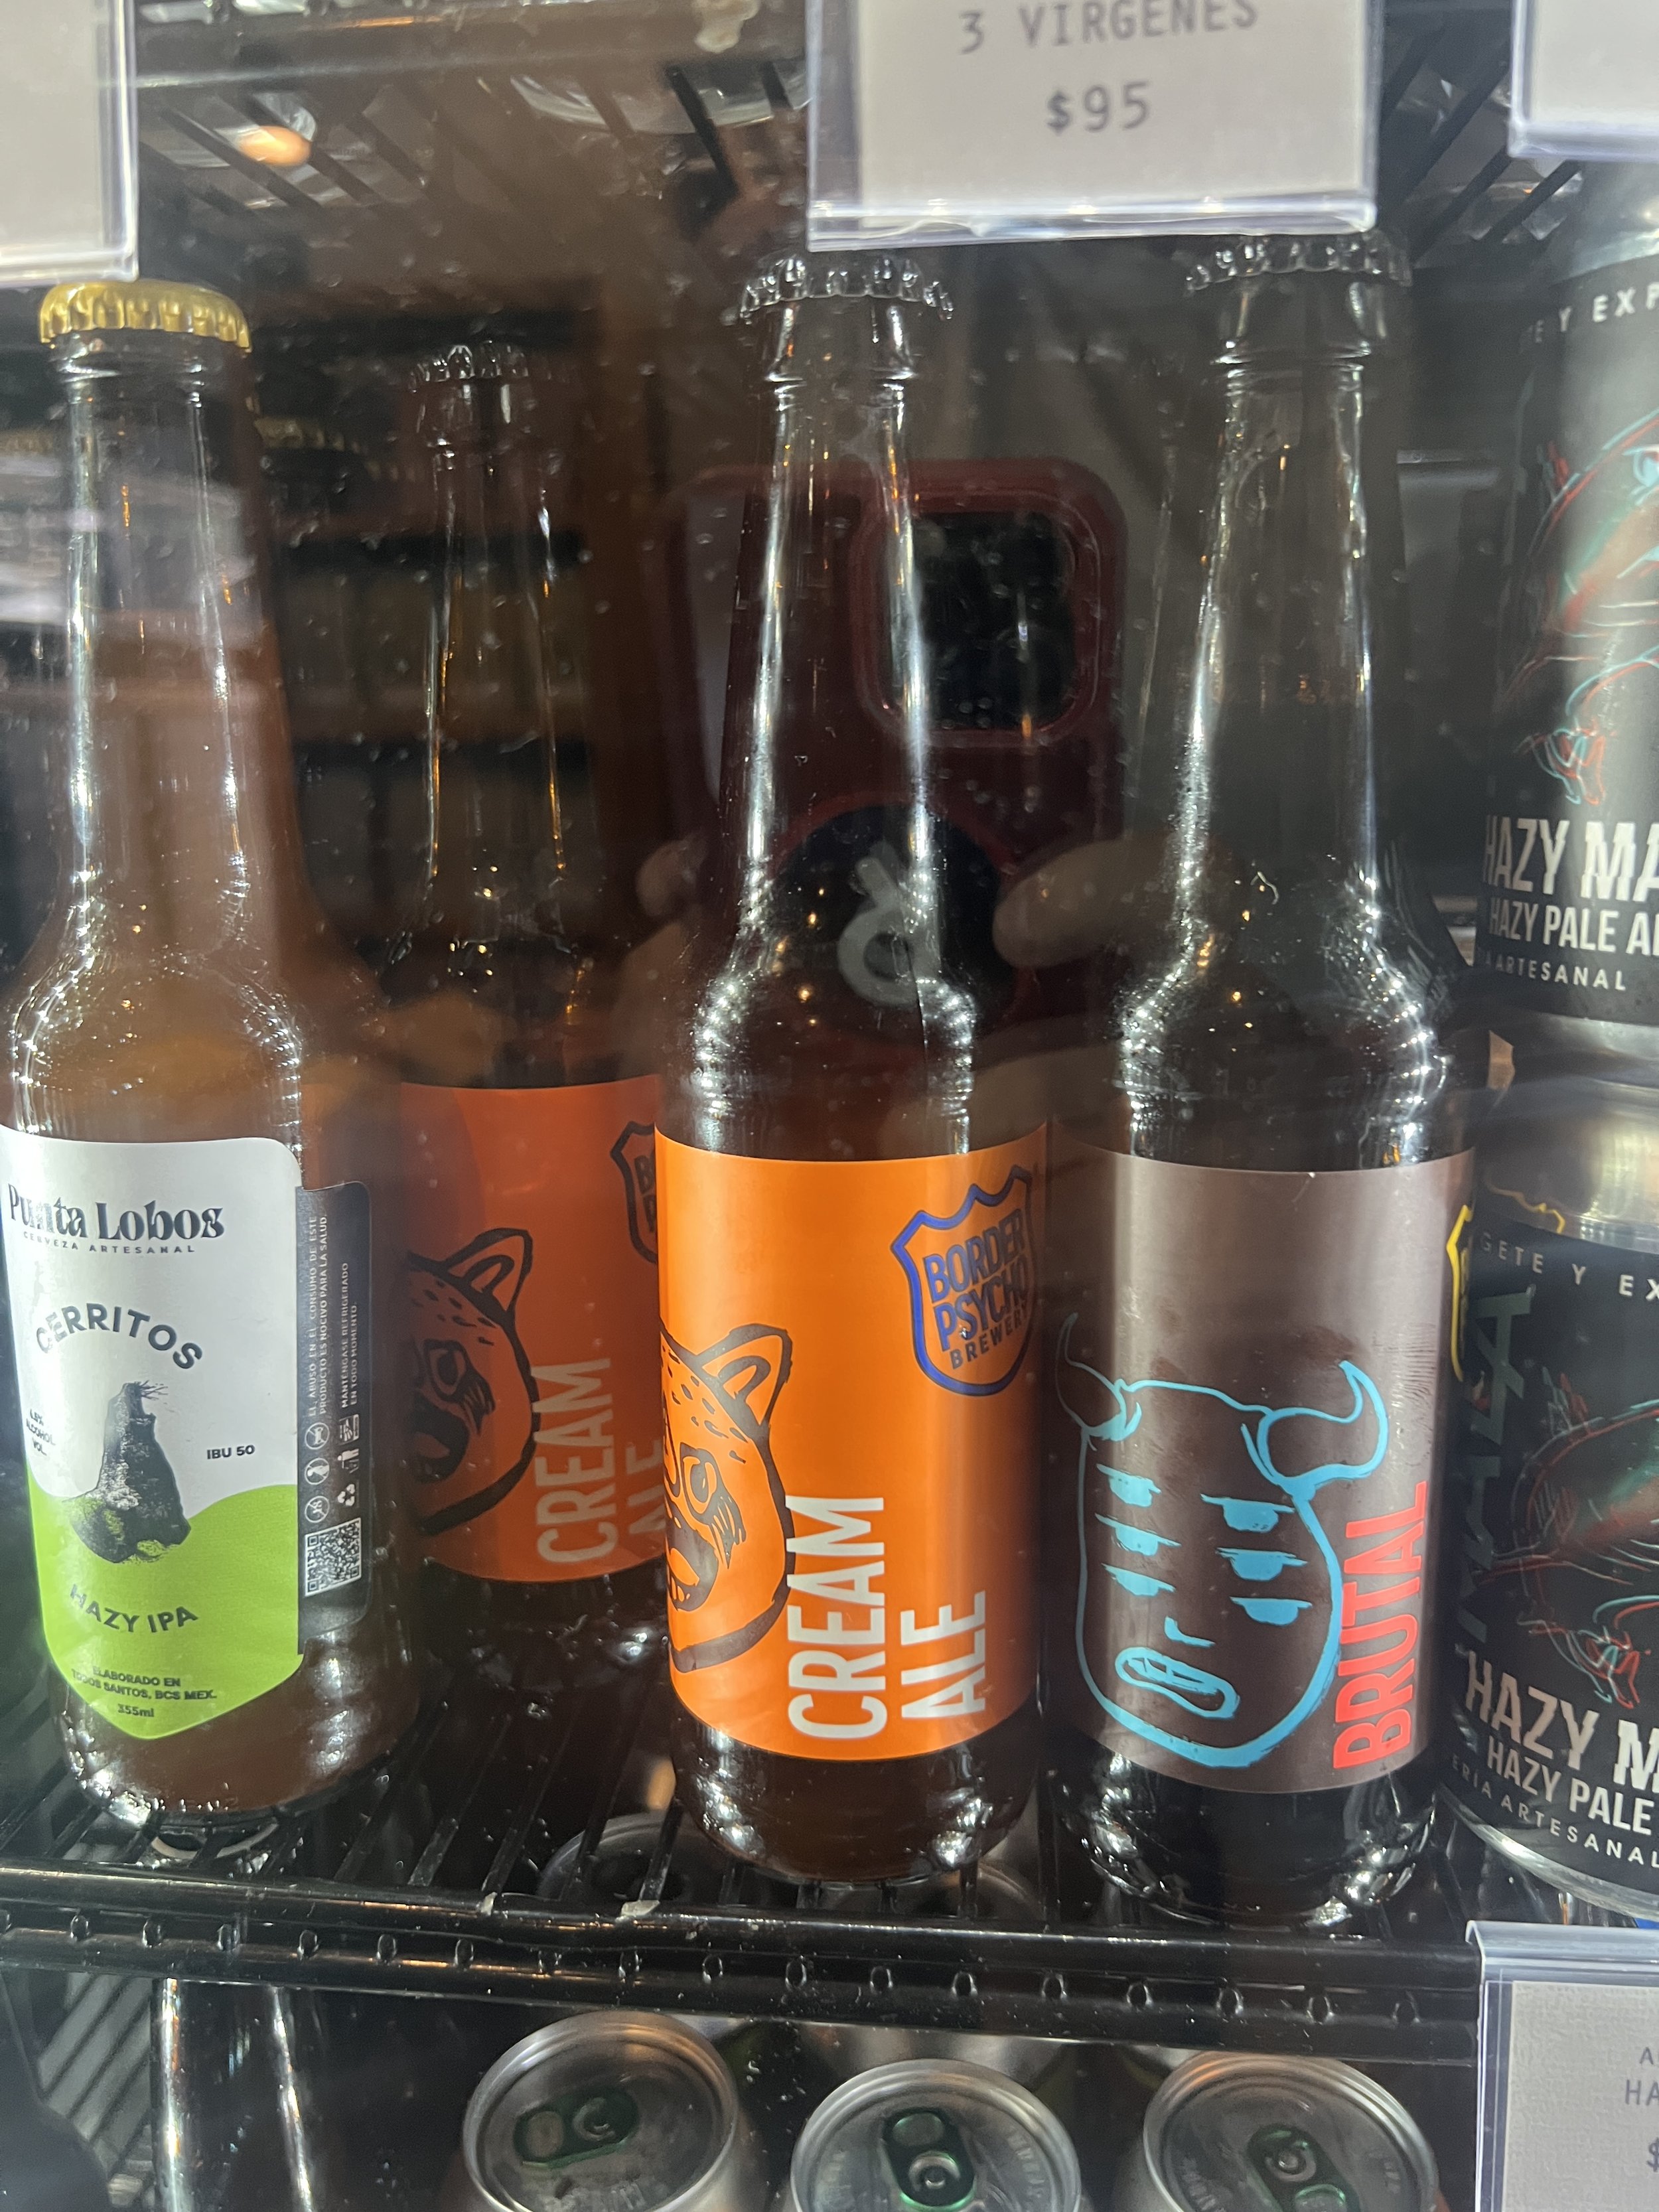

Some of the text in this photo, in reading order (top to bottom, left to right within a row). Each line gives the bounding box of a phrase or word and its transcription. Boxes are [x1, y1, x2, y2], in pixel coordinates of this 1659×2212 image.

[958, 9, 985, 55] 3
[1046, 80, 1150, 135] $95
[1483, 814, 1570, 895] HAZY
[1489, 896, 1539, 942] HAZY
[1543, 905, 1619, 954] PALE
[1494, 953, 1626, 991] ARTESANAL
[8, 1183, 225, 1241] Punta Lobos
[23, 1230, 195, 1254] CERVEZA ARTESANAL
[309, 1247, 317, 1262] DE
[320, 1253, 328, 1268] LA
[922, 1208, 1025, 1303] BORDER
[1573, 1264, 1587, 1286] Y
[934, 1252, 1031, 1352] PSYCHO
[36, 1302, 203, 1370] CERRITOS
[309, 1344, 317, 1358] EN
[320, 1343, 327, 1356] ES
[350, 1390, 358, 1406] EN
[206, 1444, 255, 1460] IBU 50
[533, 1359, 618, 1564] CREAM
[70, 1584, 198, 1633] HAZY IPA
[784, 1496, 887, 1739] CREAM
[1333, 1480, 1427, 1769] BRUTAL
[92, 1666, 181, 1687] ELABORADO EN
[901, 1589, 986, 1721] ALE
[104, 1682, 152, 1699] SANTOS,
[155, 1690, 182, 1700] BCS
[117, 1703, 155, 1718] 355ml
[1465, 1650, 1600, 1771] HAZY
[1487, 1735, 1655, 1836] HAZY PALE
[1501, 1794, 1659, 1869] ARTESANAL
